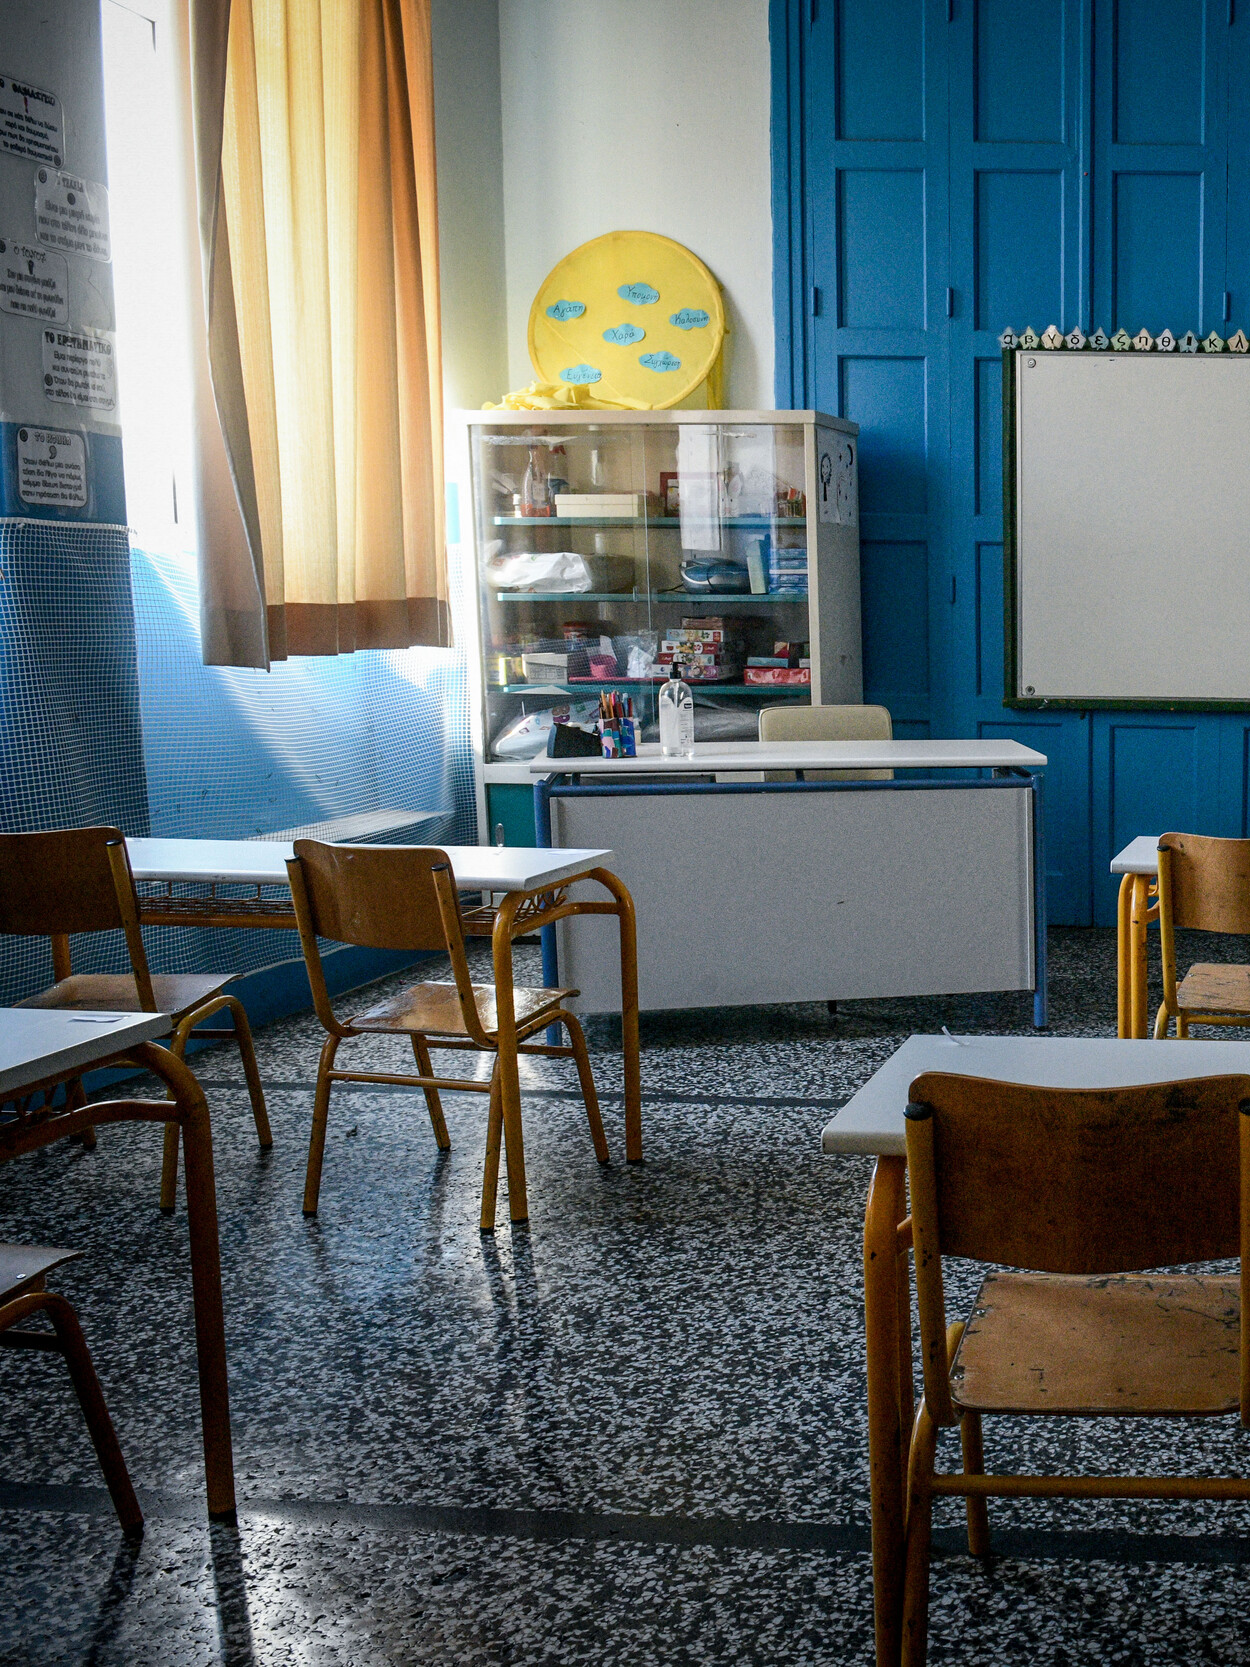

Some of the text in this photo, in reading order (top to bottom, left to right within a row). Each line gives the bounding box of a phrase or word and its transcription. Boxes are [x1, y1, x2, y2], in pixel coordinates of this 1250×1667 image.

[553, 304, 583, 317] Αγάπη
[45, 331, 55, 344] ΤΟ
[611, 329, 636, 342] Χαρά
